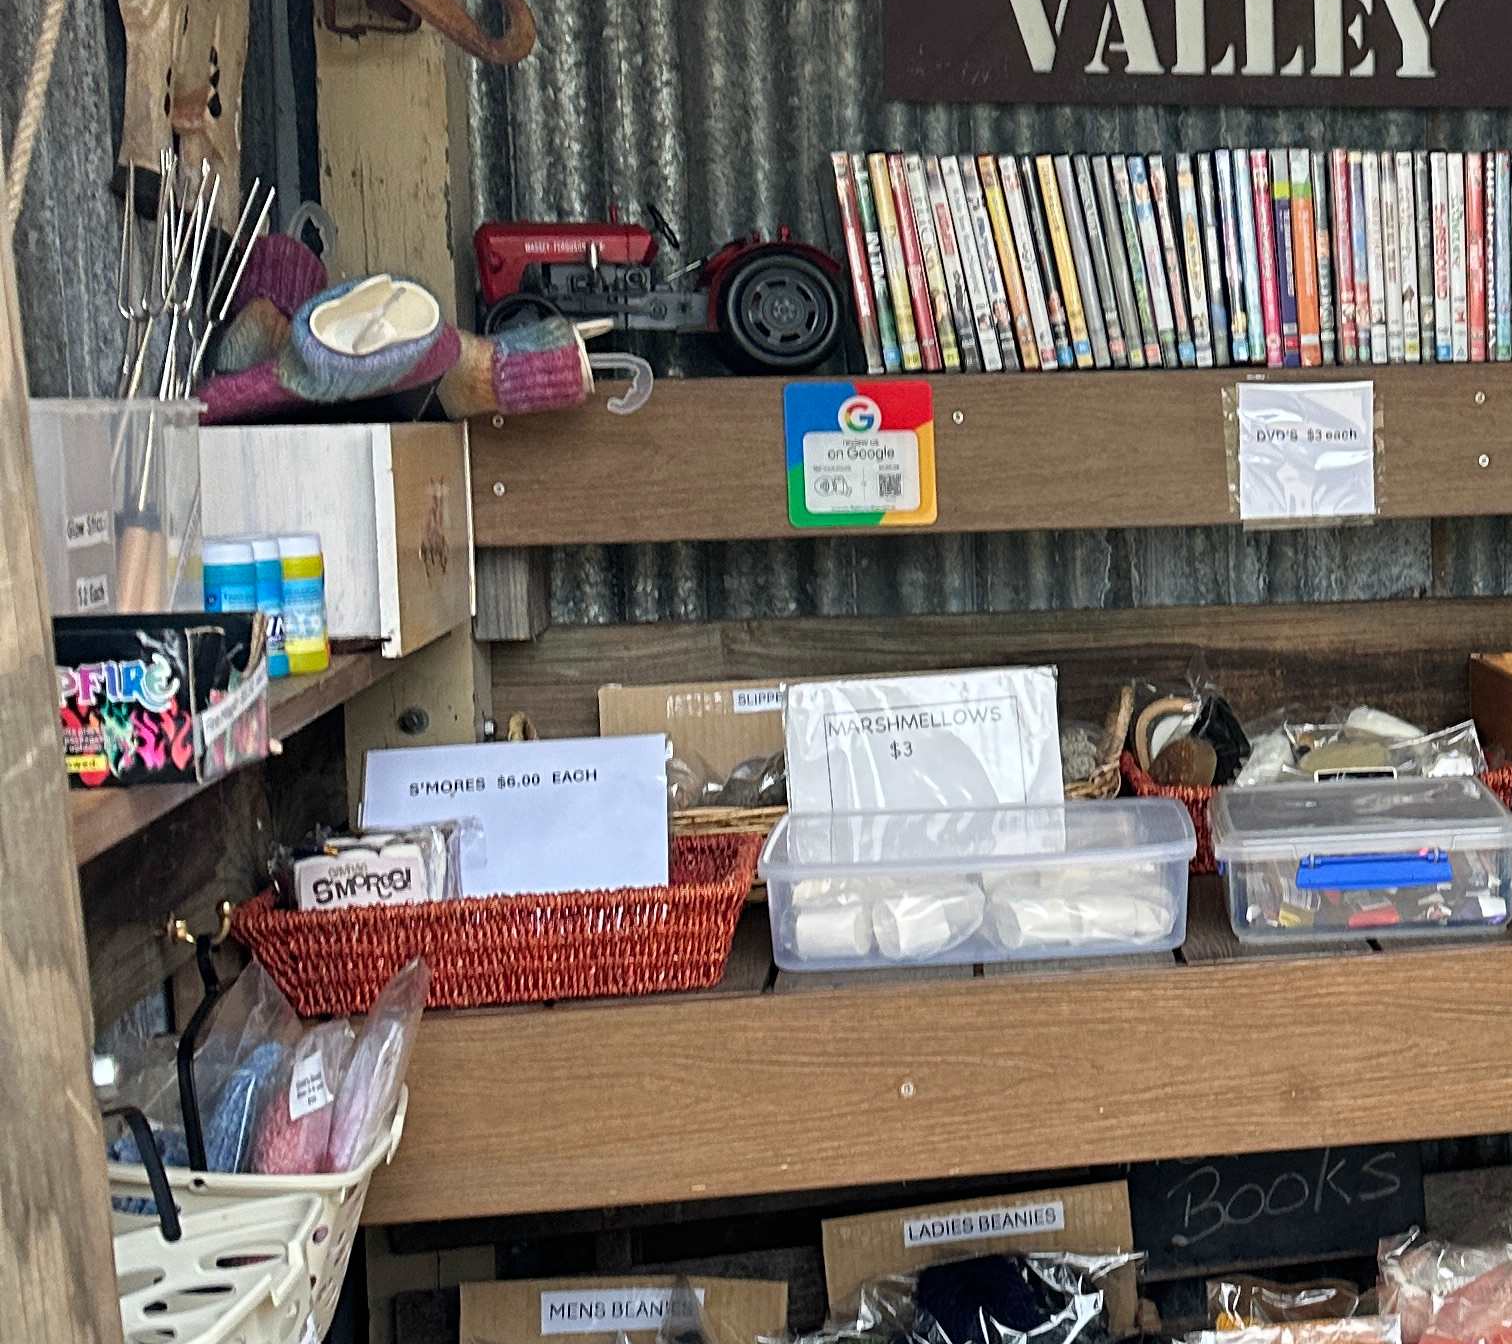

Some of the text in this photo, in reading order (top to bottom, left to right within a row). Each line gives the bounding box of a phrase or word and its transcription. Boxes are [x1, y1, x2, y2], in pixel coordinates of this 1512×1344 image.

[845, 403, 875, 432] G
[1325, 427, 1357, 442] each
[827, 445, 895, 463] on Google
[828, 706, 1003, 738] MARSHMELLOWS
[889, 739, 914, 761] $3
[409, 776, 486, 798] S'MORES
[551, 768, 598, 786] EACH
[908, 1207, 1057, 1242] LADIES BEANIES
[549, 1301, 606, 1321] MENS
